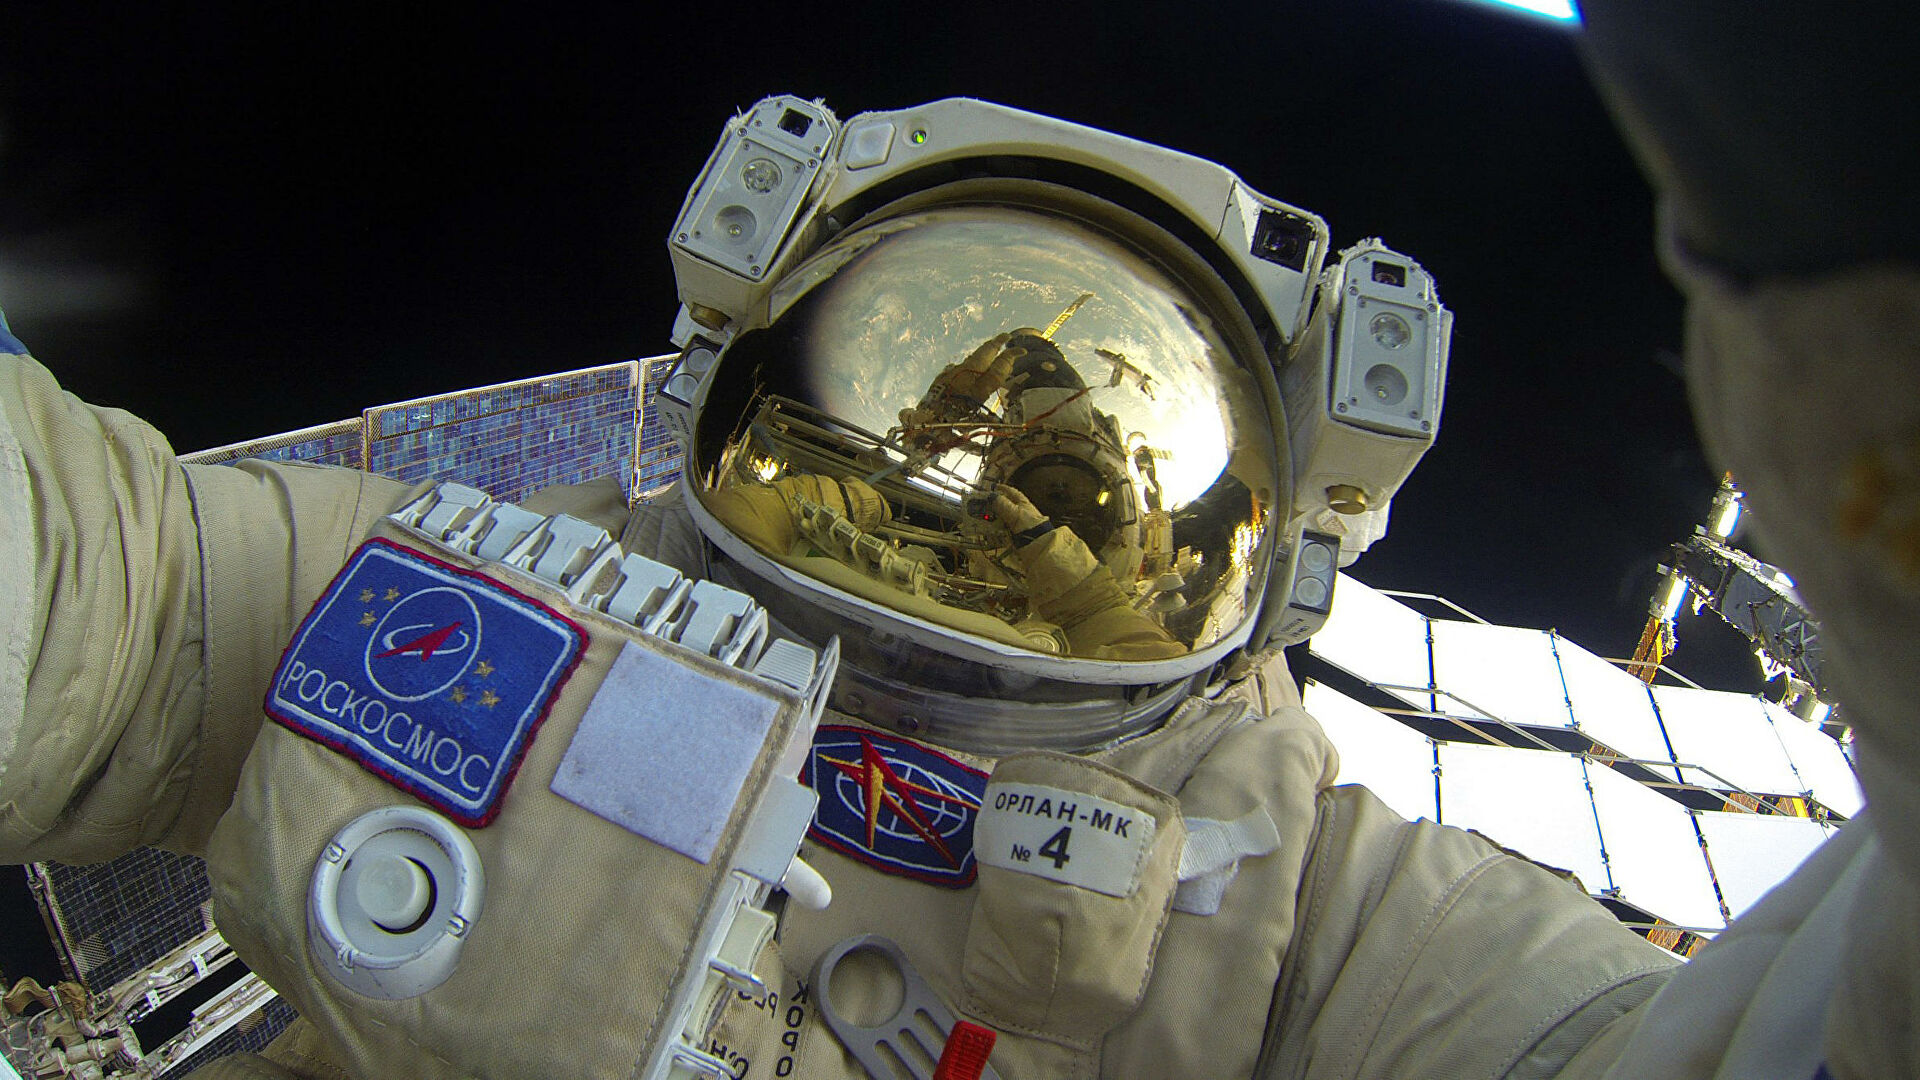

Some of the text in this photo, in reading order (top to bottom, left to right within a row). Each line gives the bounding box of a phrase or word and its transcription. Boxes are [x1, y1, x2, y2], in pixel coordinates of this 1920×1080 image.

[283, 661, 490, 793] РОСКОСМОС
[995, 792, 1132, 838] ОРЛАН-МК
[1038, 826, 1072, 869] 4
